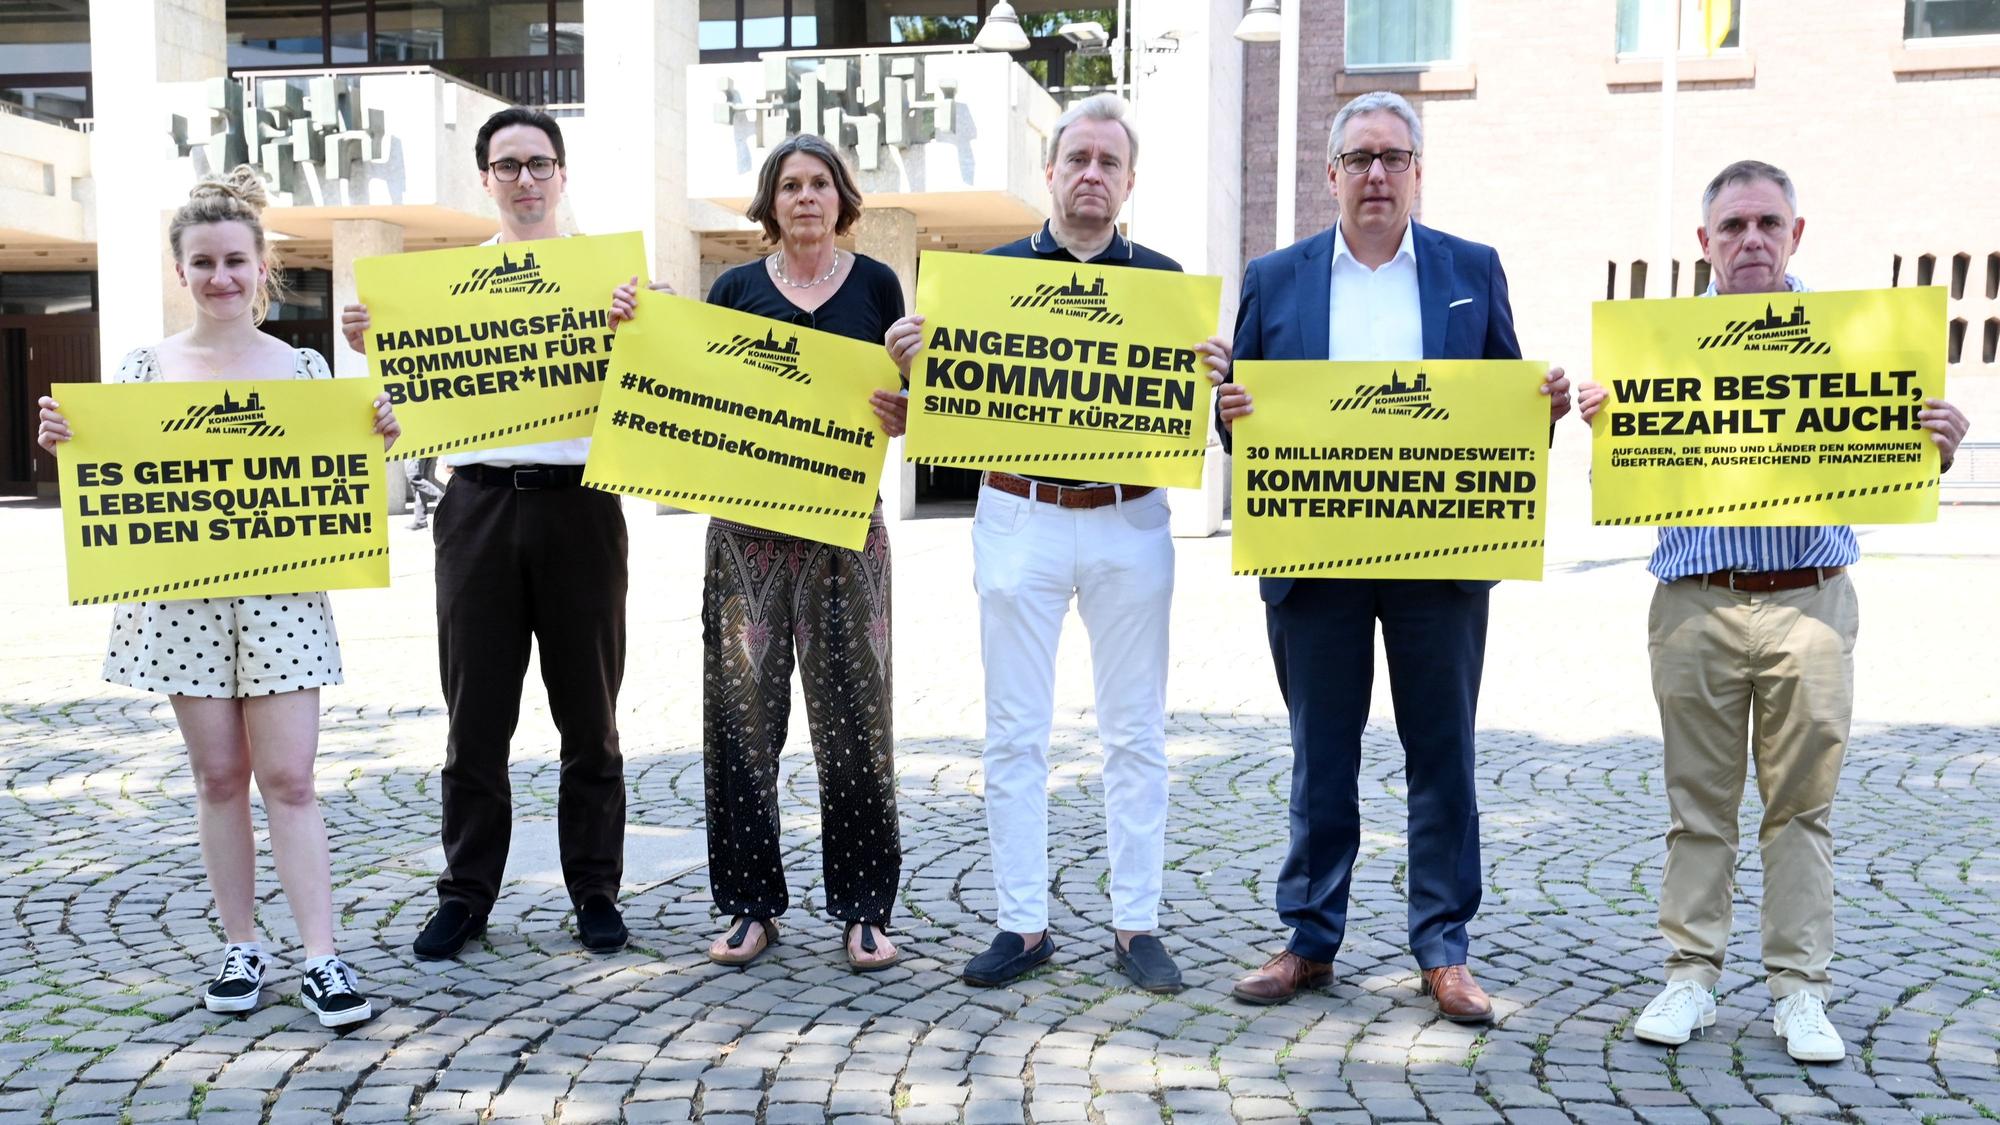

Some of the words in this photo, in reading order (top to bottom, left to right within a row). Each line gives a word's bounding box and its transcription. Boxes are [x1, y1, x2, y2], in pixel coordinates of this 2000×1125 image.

[490, 271, 540, 285] KOMMUNEN
[1050, 307, 1063, 315] AM
[1065, 309, 1088, 318] LIMIT
[1747, 328, 1808, 340] KOMMUNEN
[380, 343, 538, 376] KOMMUNEN
[545, 334, 596, 358] FÜR
[748, 350, 797, 363] KOMMUNEN
[929, 327, 1118, 365] ANGEBOTE
[1127, 344, 1196, 373] DER
[743, 358, 758, 366] AM
[757, 362, 779, 373] LIMIT
[384, 359, 609, 404] BÜRGERINNE
[925, 357, 1195, 411] KOMMUNEN
[1613, 378, 1702, 403] WER
[1714, 371, 1923, 401] BESTELLT,
[620, 372, 875, 448] #KommunenAmLimit
[1375, 394, 1430, 405] KOMMUNEN
[208, 412, 264, 425] KOMMUNEN
[924, 396, 981, 415] SIND
[988, 401, 1063, 424] NICHT
[1069, 406, 1192, 435] KÜRZBAR!
[1371, 407, 1386, 415] AM
[1388, 408, 1412, 416] LIMIT
[1612, 408, 1786, 436] BEZAHLT
[1795, 405, 1923, 433] AUCH!
[223, 426, 247, 434] LIMIT
[612, 410, 866, 484] #RettetDieKommunen
[1247, 446, 1269, 460] 30
[1275, 447, 1393, 460] MILLIARDEN
[1399, 448, 1535, 461] BUNDESWEIT:
[1612, 447, 1676, 456] AUFGABEN,
[1682, 446, 1701, 454] DIE
[1704, 446, 1737, 454] BUND
[1740, 445, 1765, 453] UND
[1768, 442, 1816, 453] LÄNDER
[1820, 444, 1844, 452] DEN
[1847, 442, 1922, 451] KOMMUNEN
[77, 462, 123, 487] ES
[134, 459, 233, 484] GEHT
[244, 456, 300, 481] UM
[312, 454, 369, 478] DIE
[1612, 455, 1707, 468] ÜBERTRAGEN,
[1711, 455, 1811, 465] AUSREICHEND
[1819, 453, 1921, 464] FINANZIEREN!
[1248, 469, 1445, 492] KOMMUNEN
[1455, 470, 1536, 493] SIND
[79, 479, 369, 517] LEBENSQUALITÄT
[1247, 498, 1536, 520] UNTERFINANZIERT!
[81, 524, 117, 548] IN
[129, 520, 198, 544] DEN
[209, 511, 372, 541] STÄDTEN!
